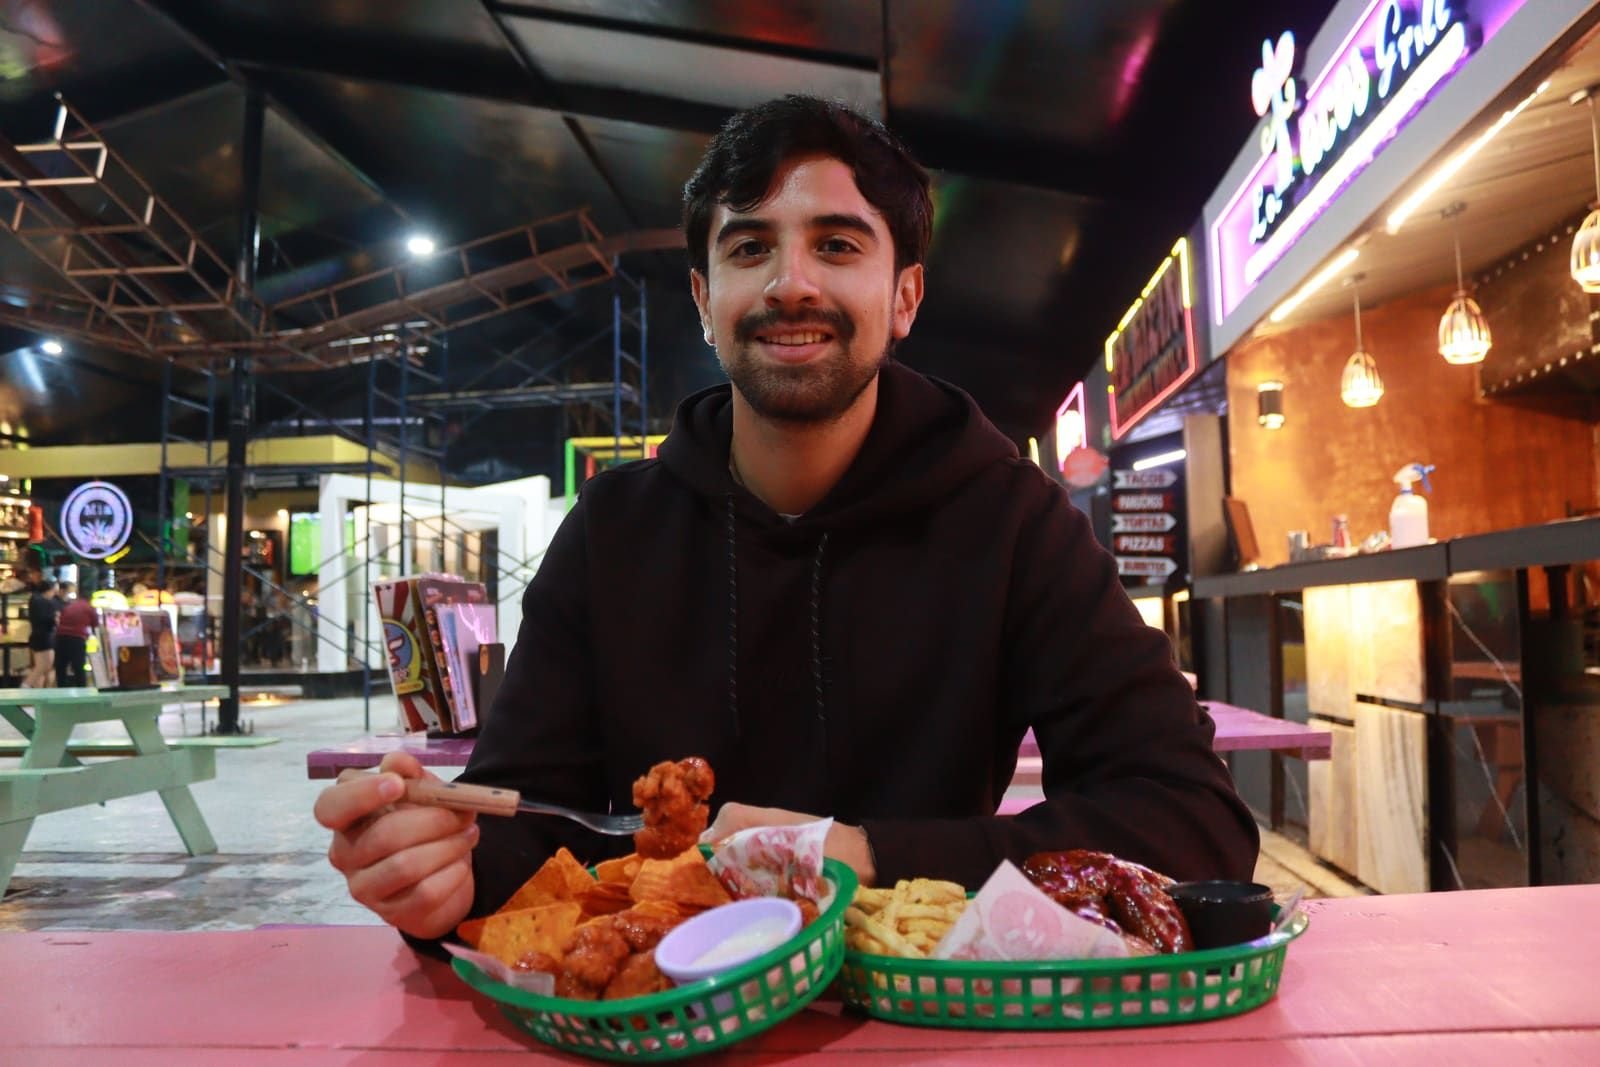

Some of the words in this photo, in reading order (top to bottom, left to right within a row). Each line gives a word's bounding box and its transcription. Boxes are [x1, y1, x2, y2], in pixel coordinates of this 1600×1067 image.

[1124, 473, 1165, 485] TACOS
[1122, 515, 1166, 528] TORTAS
[1120, 537, 1164, 551] PIZZAS
